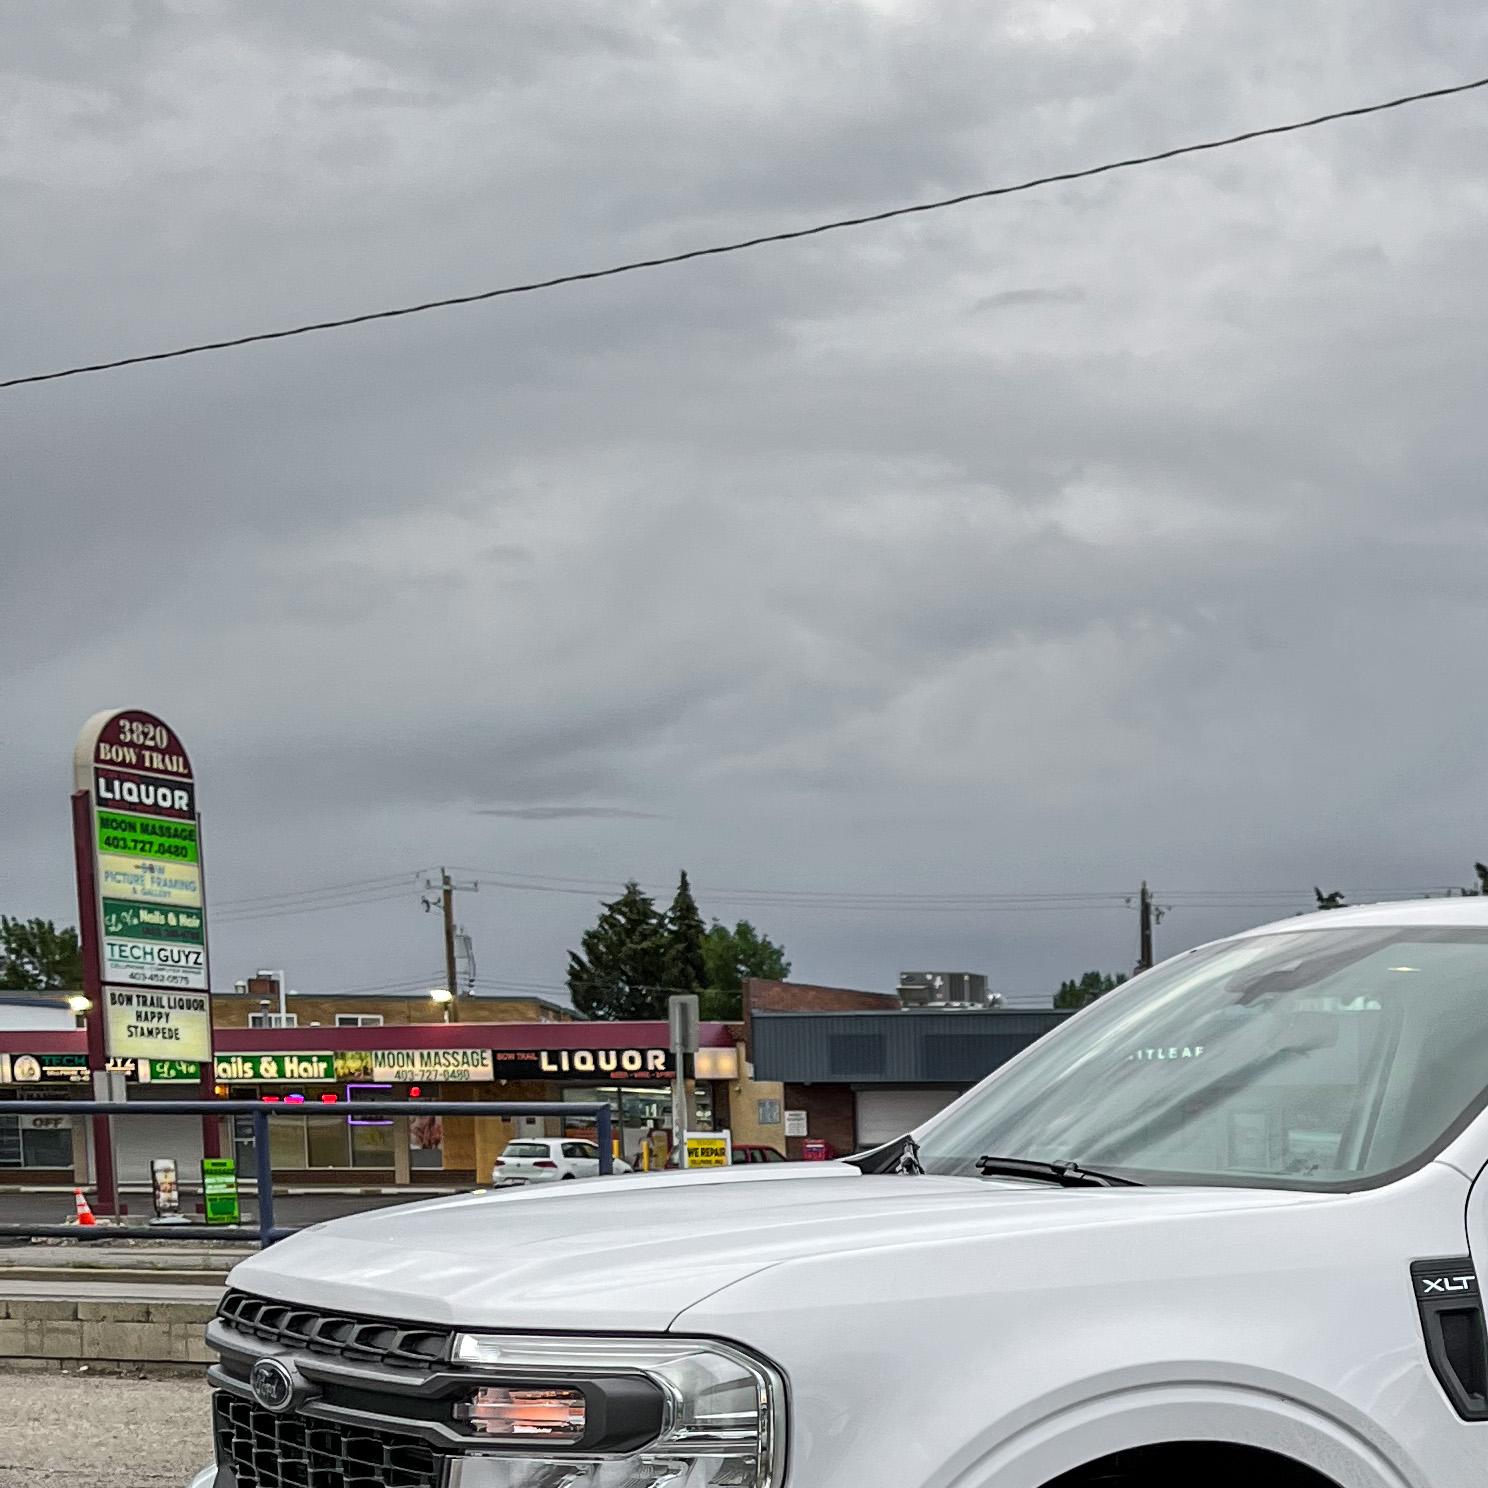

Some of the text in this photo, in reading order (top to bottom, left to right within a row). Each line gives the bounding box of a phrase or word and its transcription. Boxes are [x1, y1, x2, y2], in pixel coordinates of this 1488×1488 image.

[119, 719, 169, 749] 3820
[99, 743, 189, 774] BOW TRAIL
[98, 777, 190, 811] LIQUOR
[100, 817, 197, 842] MOON MASSAGE
[110, 992, 205, 1012] BOW TRAIL LIQUOR
[135, 1010, 170, 1024] HAPPY
[127, 1025, 181, 1041] STAMPEDE
[259, 1056, 279, 1079] &
[284, 1056, 328, 1079] Hair
[374, 1050, 490, 1069] MOON MASSAGE
[540, 1050, 666, 1071] LIQUOR
[1422, 1275, 1476, 1293] XLT
